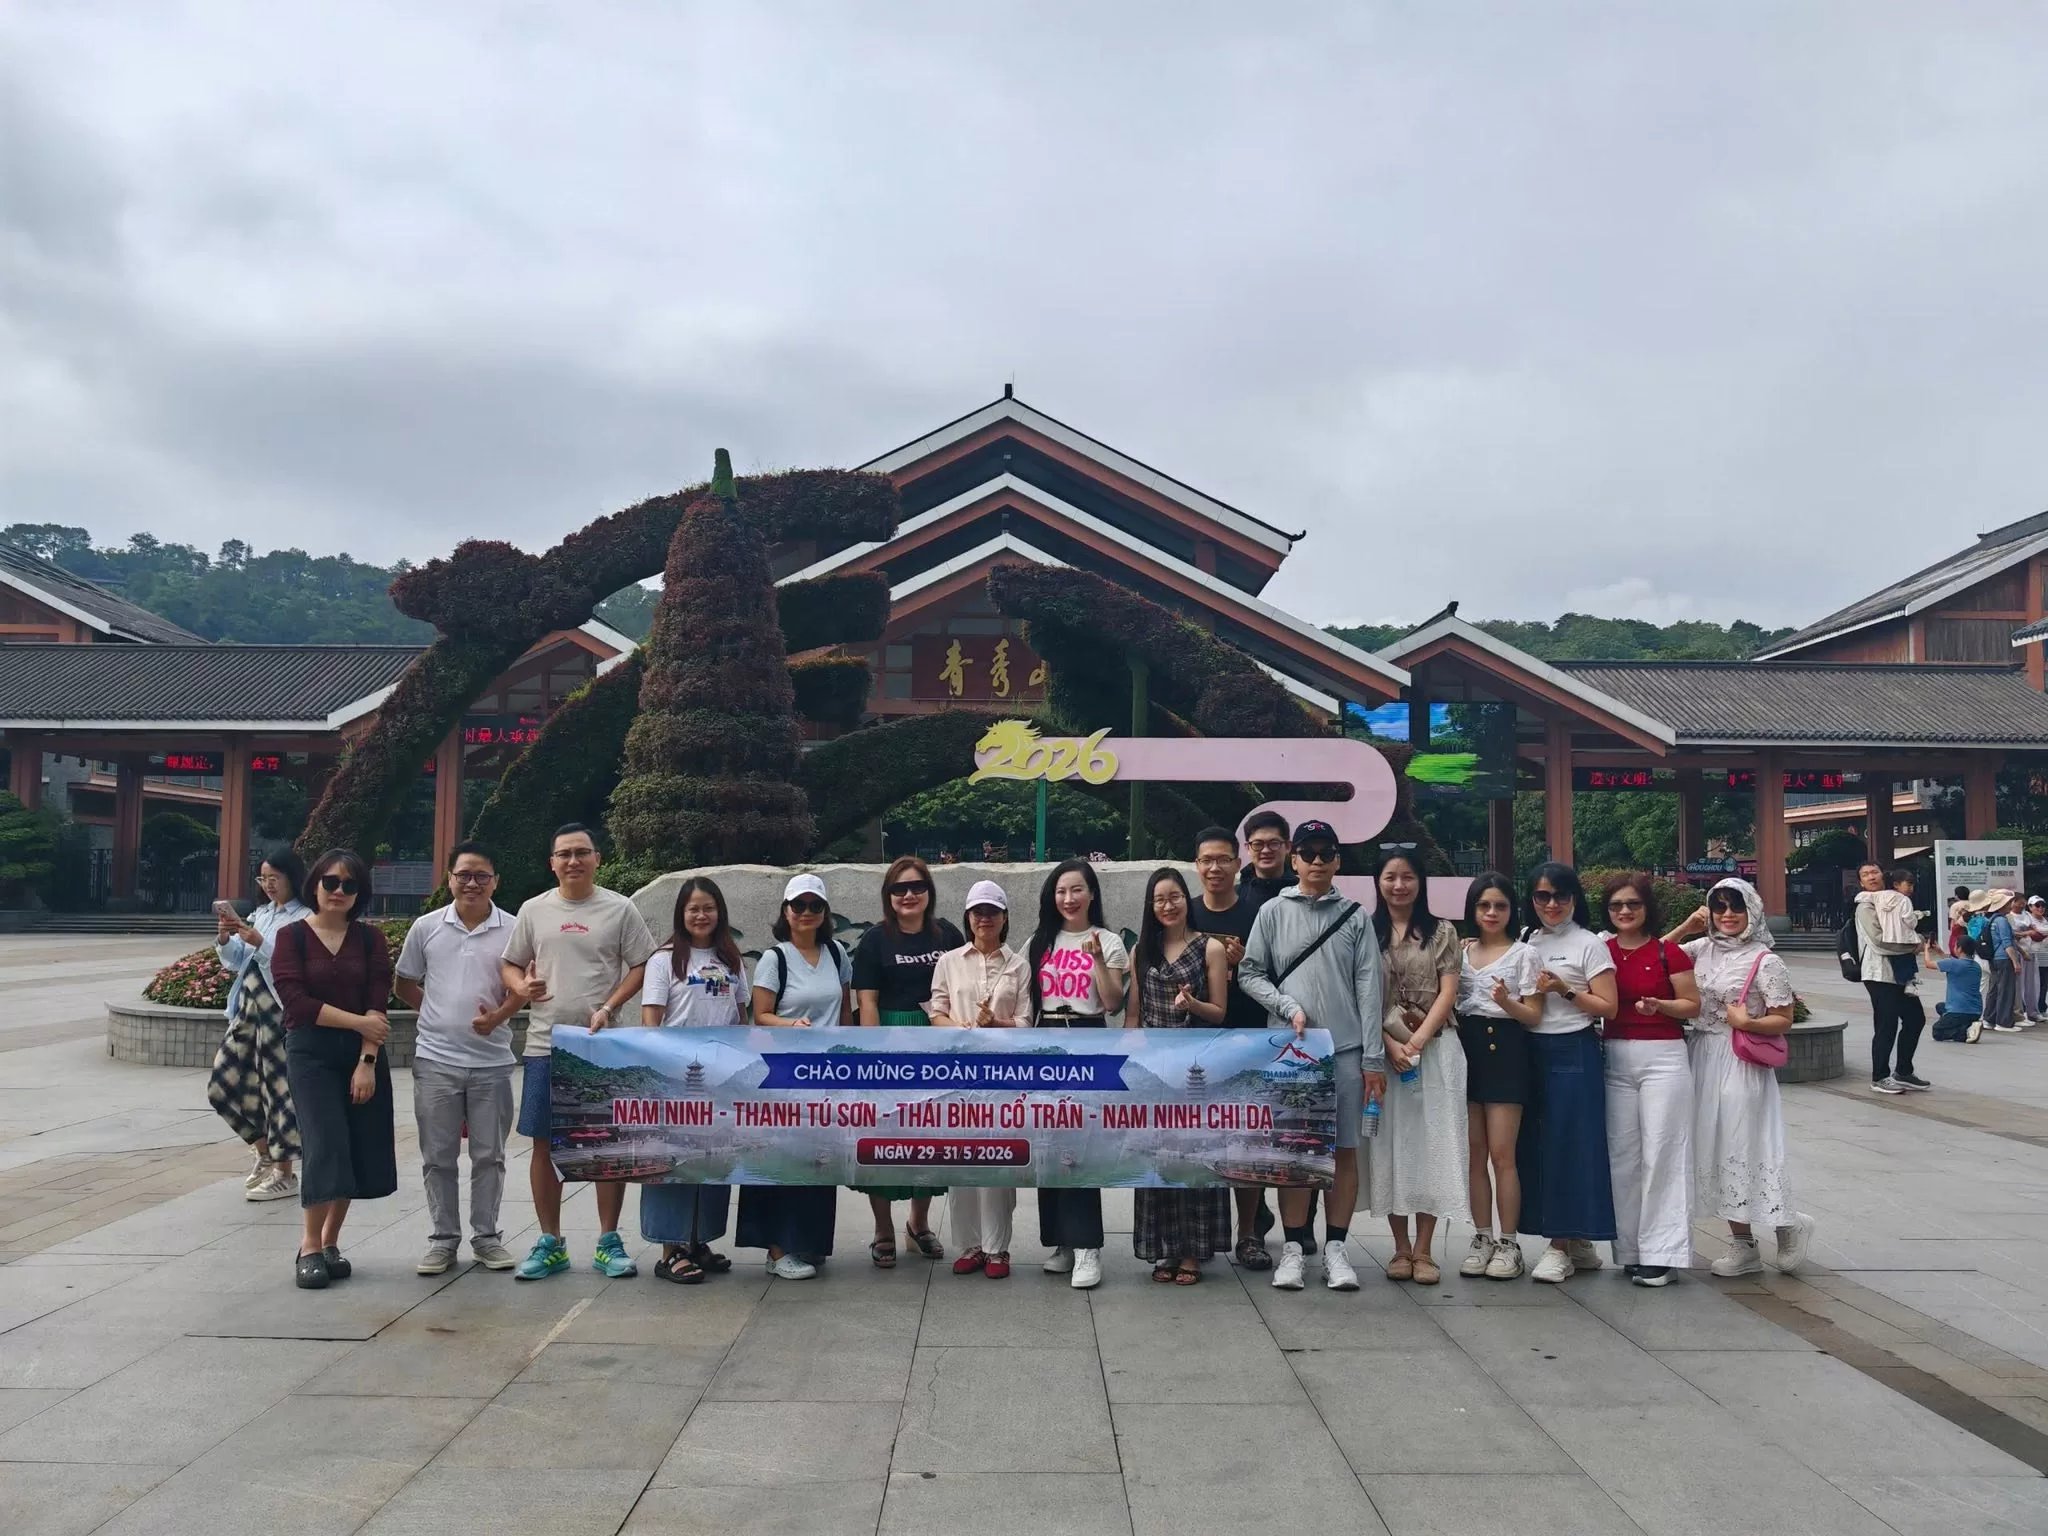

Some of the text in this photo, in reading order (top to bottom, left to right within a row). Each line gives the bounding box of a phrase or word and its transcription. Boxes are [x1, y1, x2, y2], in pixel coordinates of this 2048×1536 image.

[968, 719, 1119, 785] 2026
[1039, 970, 1092, 1000] DIOR
[794, 1059, 1094, 1082] CHÀO MỪNG ĐOÀN THAM QUAN
[613, 1099, 659, 1126] NAM
[665, 1100, 713, 1126] NINH
[733, 1101, 801, 1127] THANH
[806, 1097, 832, 1127] TÚ
[837, 1101, 876, 1127] SƠN
[897, 1097, 941, 1128] THÁI
[948, 1097, 994, 1129] BÌNH
[1000, 1093, 1028, 1129] CỔ
[1030, 1096, 1083, 1129] TRẤN
[1103, 1104, 1147, 1129] NAM
[1153, 1104, 1201, 1129] NINH
[1207, 1104, 1240, 1130] CHI
[1246, 1104, 1274, 1135] DẠ
[873, 1143, 914, 1160] NGÀY
